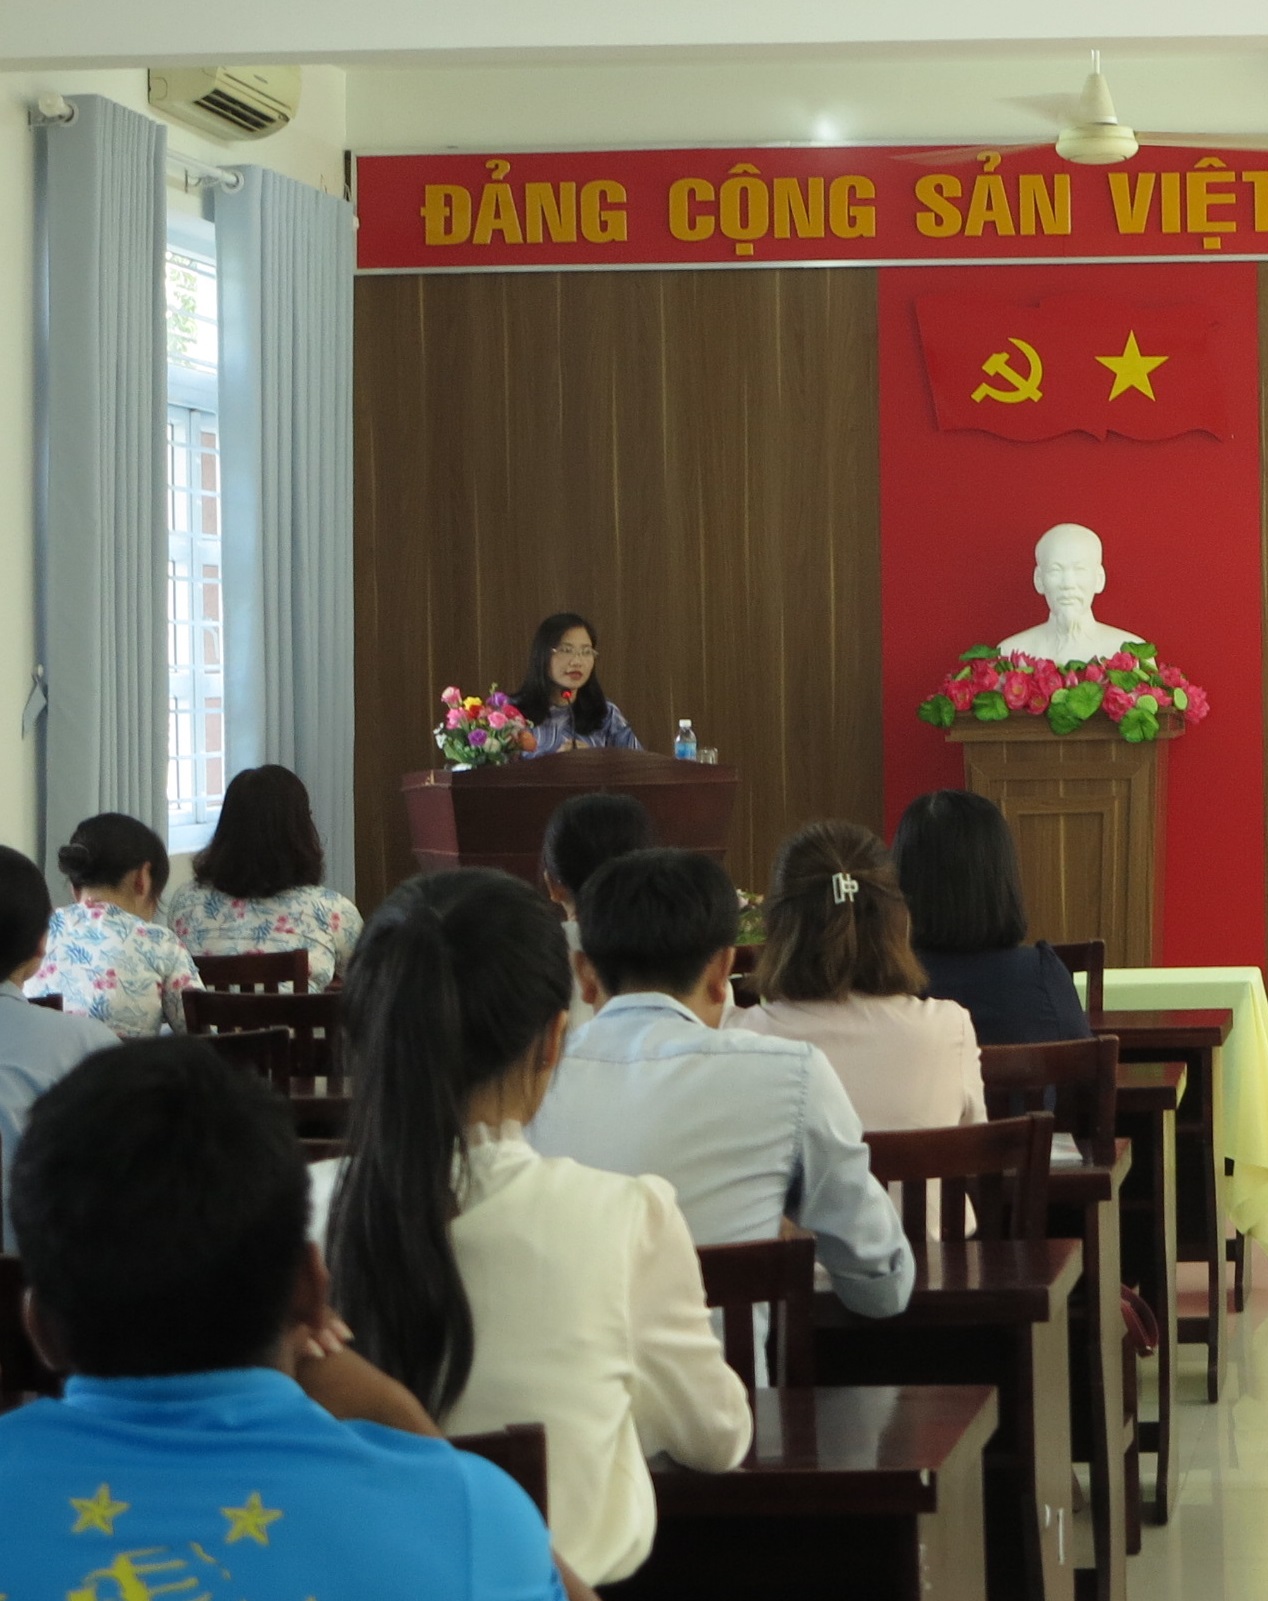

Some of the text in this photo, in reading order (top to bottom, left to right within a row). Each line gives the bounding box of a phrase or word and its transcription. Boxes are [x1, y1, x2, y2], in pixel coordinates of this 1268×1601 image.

[421, 160, 628, 246] ĐẢNG
[668, 163, 876, 256] CỘNG
[915, 154, 1072, 237] SẢN
